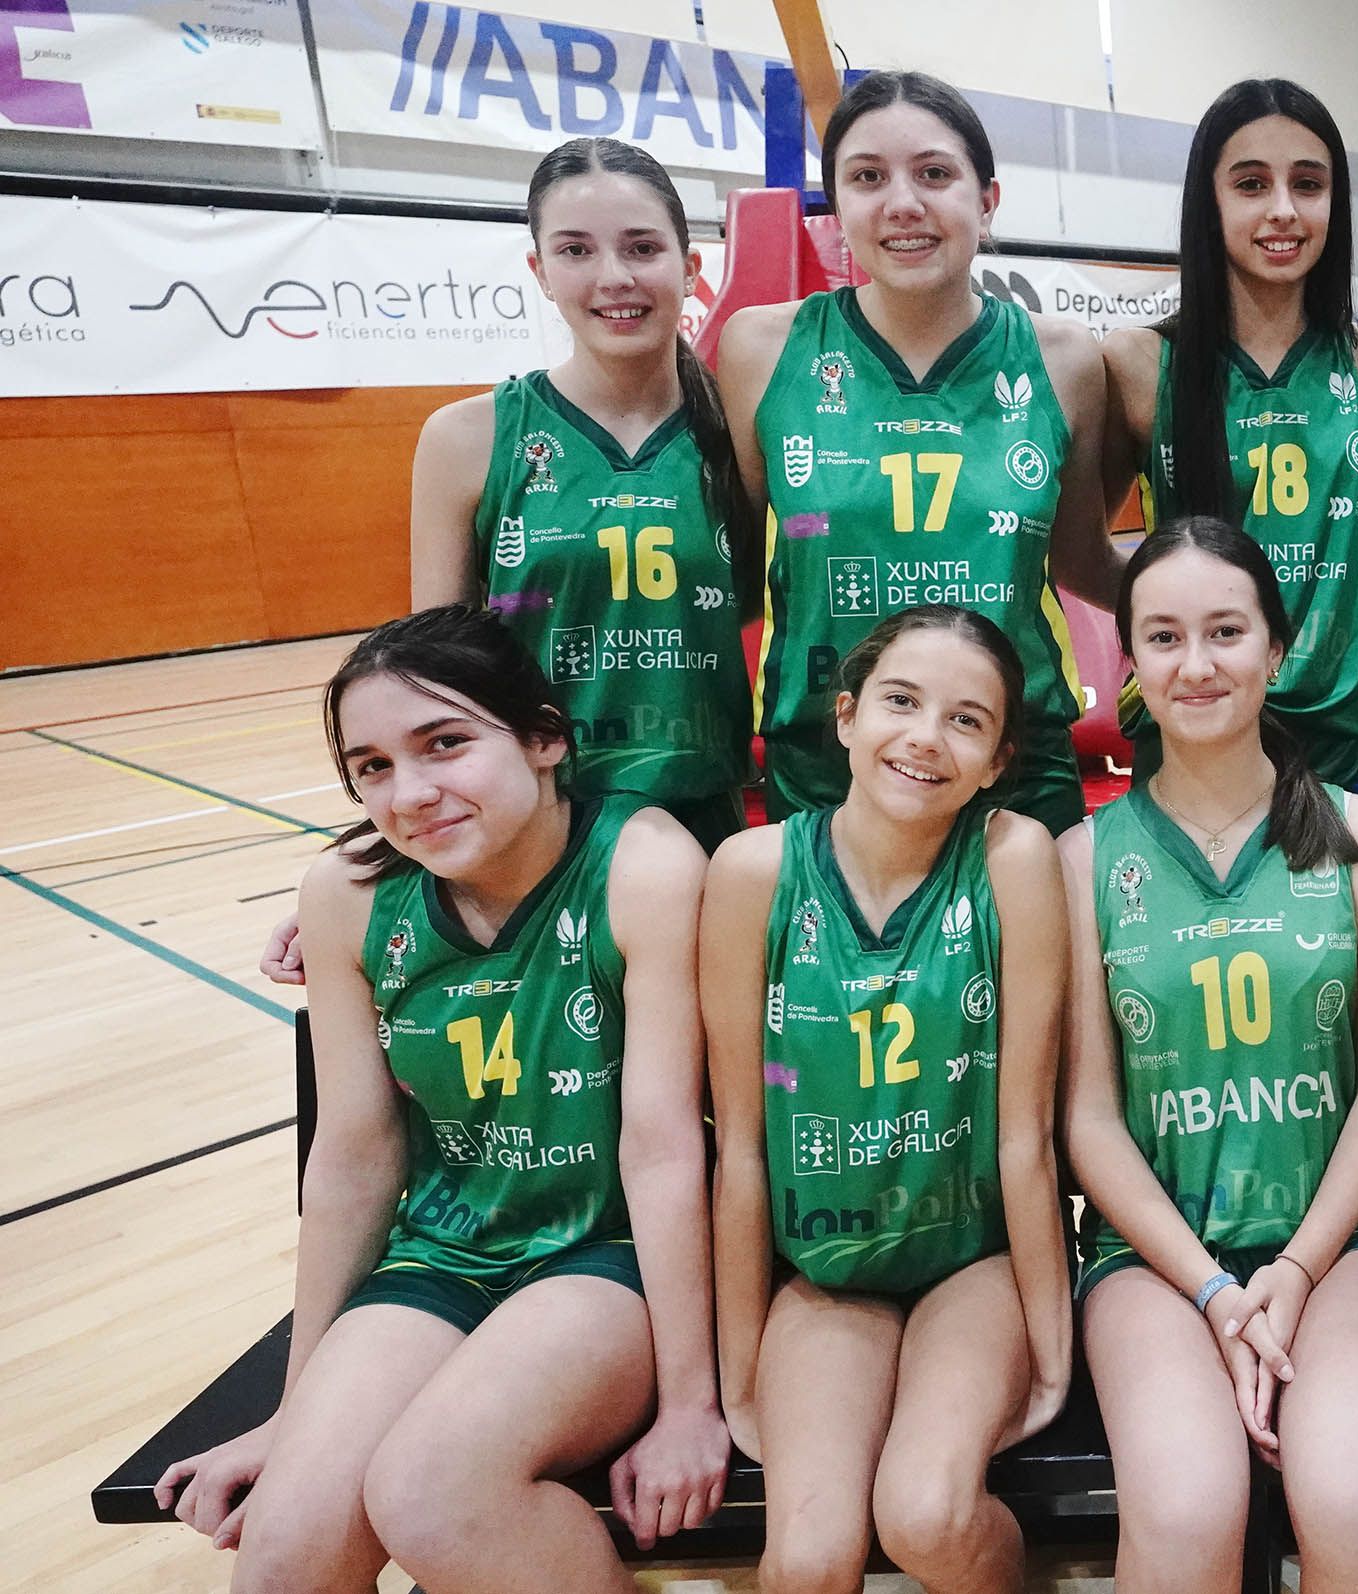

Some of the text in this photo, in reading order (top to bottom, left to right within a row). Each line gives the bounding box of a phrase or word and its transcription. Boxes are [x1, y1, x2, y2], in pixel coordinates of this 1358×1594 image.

[1002, 411, 1028, 423] LF2
[817, 449, 849, 457] Concello
[525, 483, 559, 495] ARXIL
[1247, 443, 1310, 516] 18
[880, 452, 963, 533] 17
[529, 527, 562, 536] Concello
[540, 532, 586, 543] Pontevedra
[597, 525, 678, 600] 16
[1261, 543, 1316, 562] UNTA
[886, 560, 970, 581] XUNTA
[887, 583, 1015, 605] DE GALICIA
[603, 628, 683, 648] XUNTA
[602, 651, 718, 671] DE GALICIA
[1119, 912, 1149, 928] ARXIL
[945, 942, 971, 956] LF2
[1190, 951, 1272, 1050] 10
[447, 1011, 522, 1100] 14
[848, 1003, 920, 1088] 12
[848, 1109, 929, 1143] XUNTA
[849, 1116, 972, 1166] DE GALICIA
[498, 1143, 596, 1171] GALICIA
